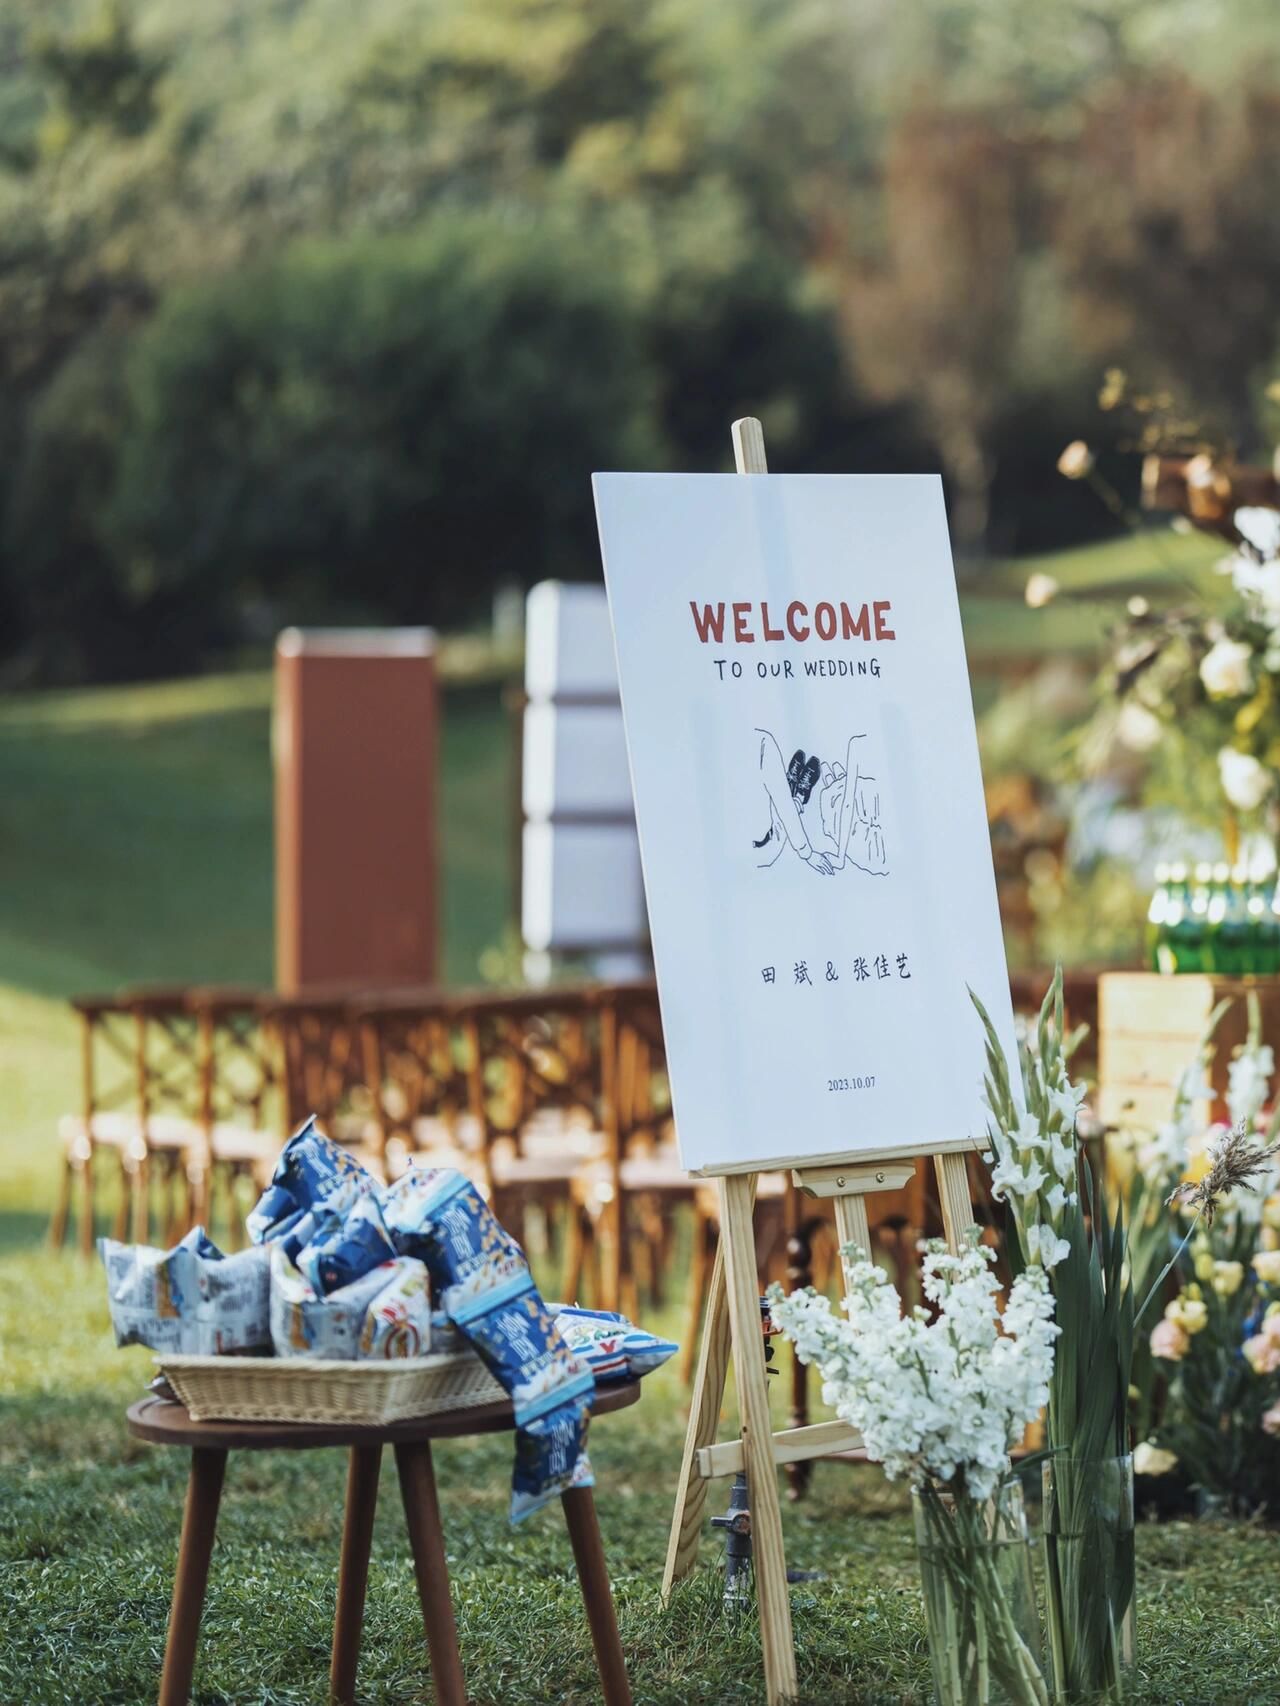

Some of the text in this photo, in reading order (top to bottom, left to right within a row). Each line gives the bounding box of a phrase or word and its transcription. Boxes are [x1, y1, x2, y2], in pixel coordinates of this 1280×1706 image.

[690, 600, 896, 643] WELCOME
[714, 658, 881, 681] TO OUR WEDDING
[825, 961, 840, 982] &
[853, 952, 912, 982] 张佳艺
[827, 1076, 875, 1092] 2023.10.07
